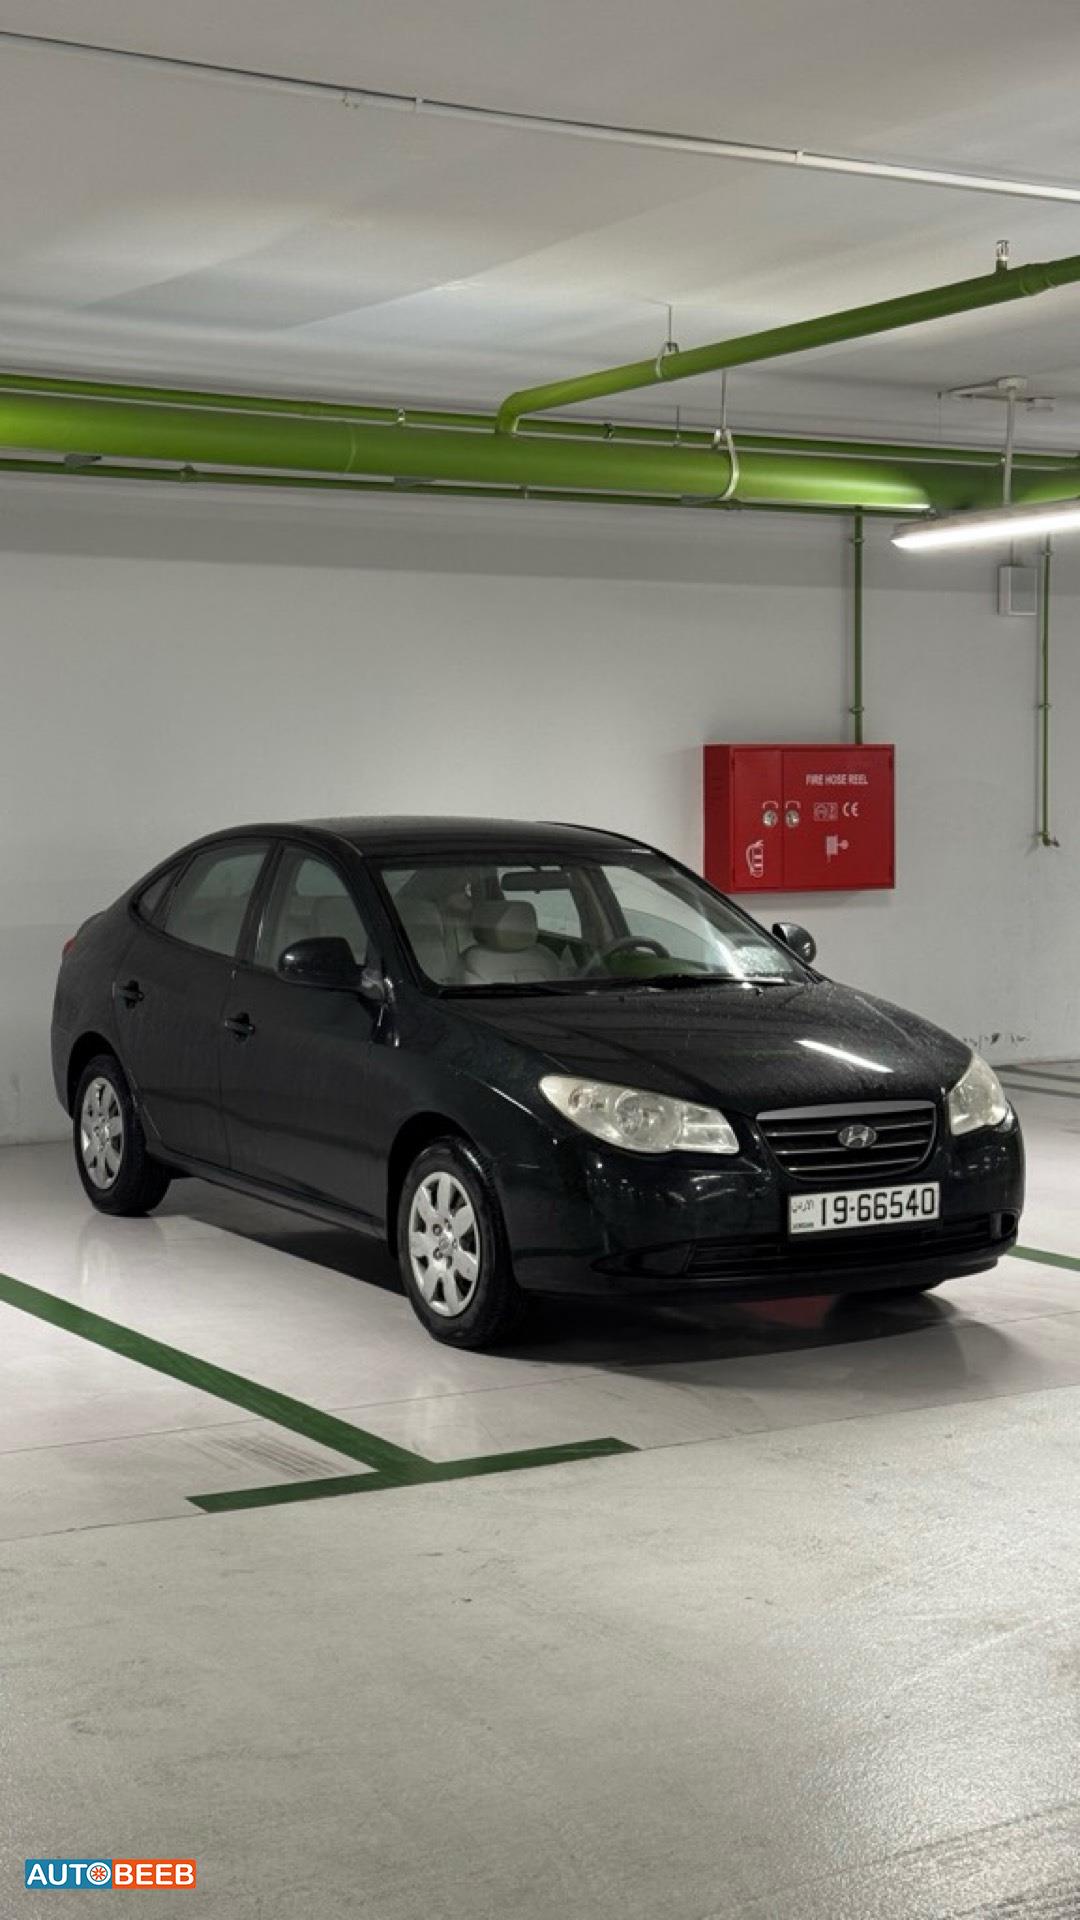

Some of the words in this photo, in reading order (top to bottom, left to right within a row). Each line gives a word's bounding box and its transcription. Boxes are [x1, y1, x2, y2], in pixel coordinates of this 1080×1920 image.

[805, 773, 824, 786] FIRE
[824, 773, 847, 785] HOSE
[848, 773, 869, 785] REEL
[821, 1187, 936, 1227] 19-66540
